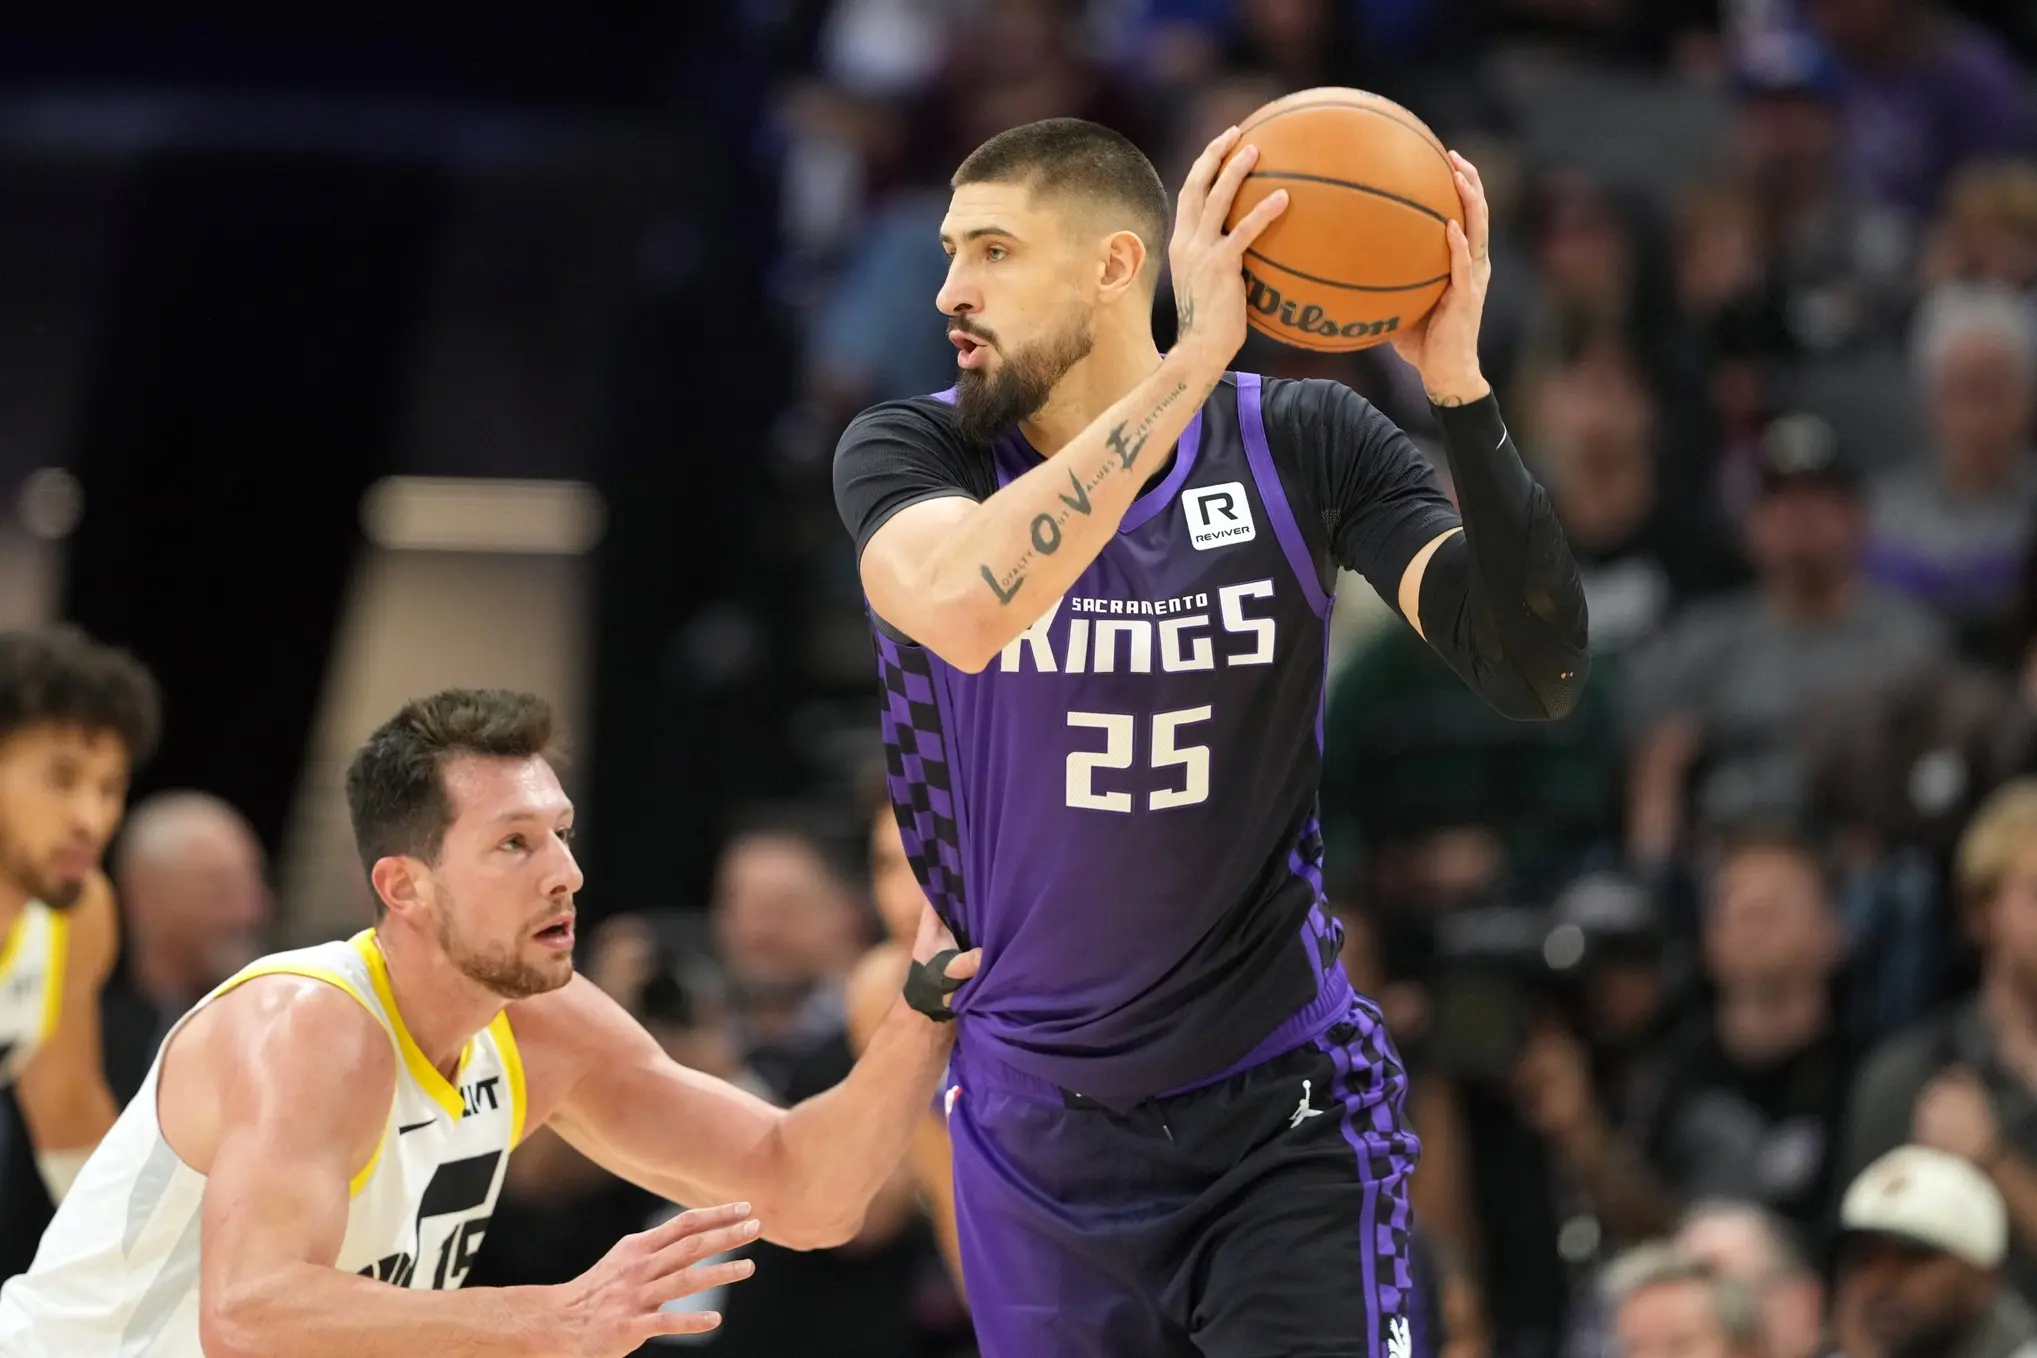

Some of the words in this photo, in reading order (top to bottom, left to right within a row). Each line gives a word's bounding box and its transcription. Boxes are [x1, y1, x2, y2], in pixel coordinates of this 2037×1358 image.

[1243, 267, 1399, 338] Wilson
[1195, 525, 1250, 543] REVIVER
[1000, 578, 1276, 674] KINGS
[1071, 592, 1209, 616] SACRAMENTO
[1065, 704, 1213, 813] 25
